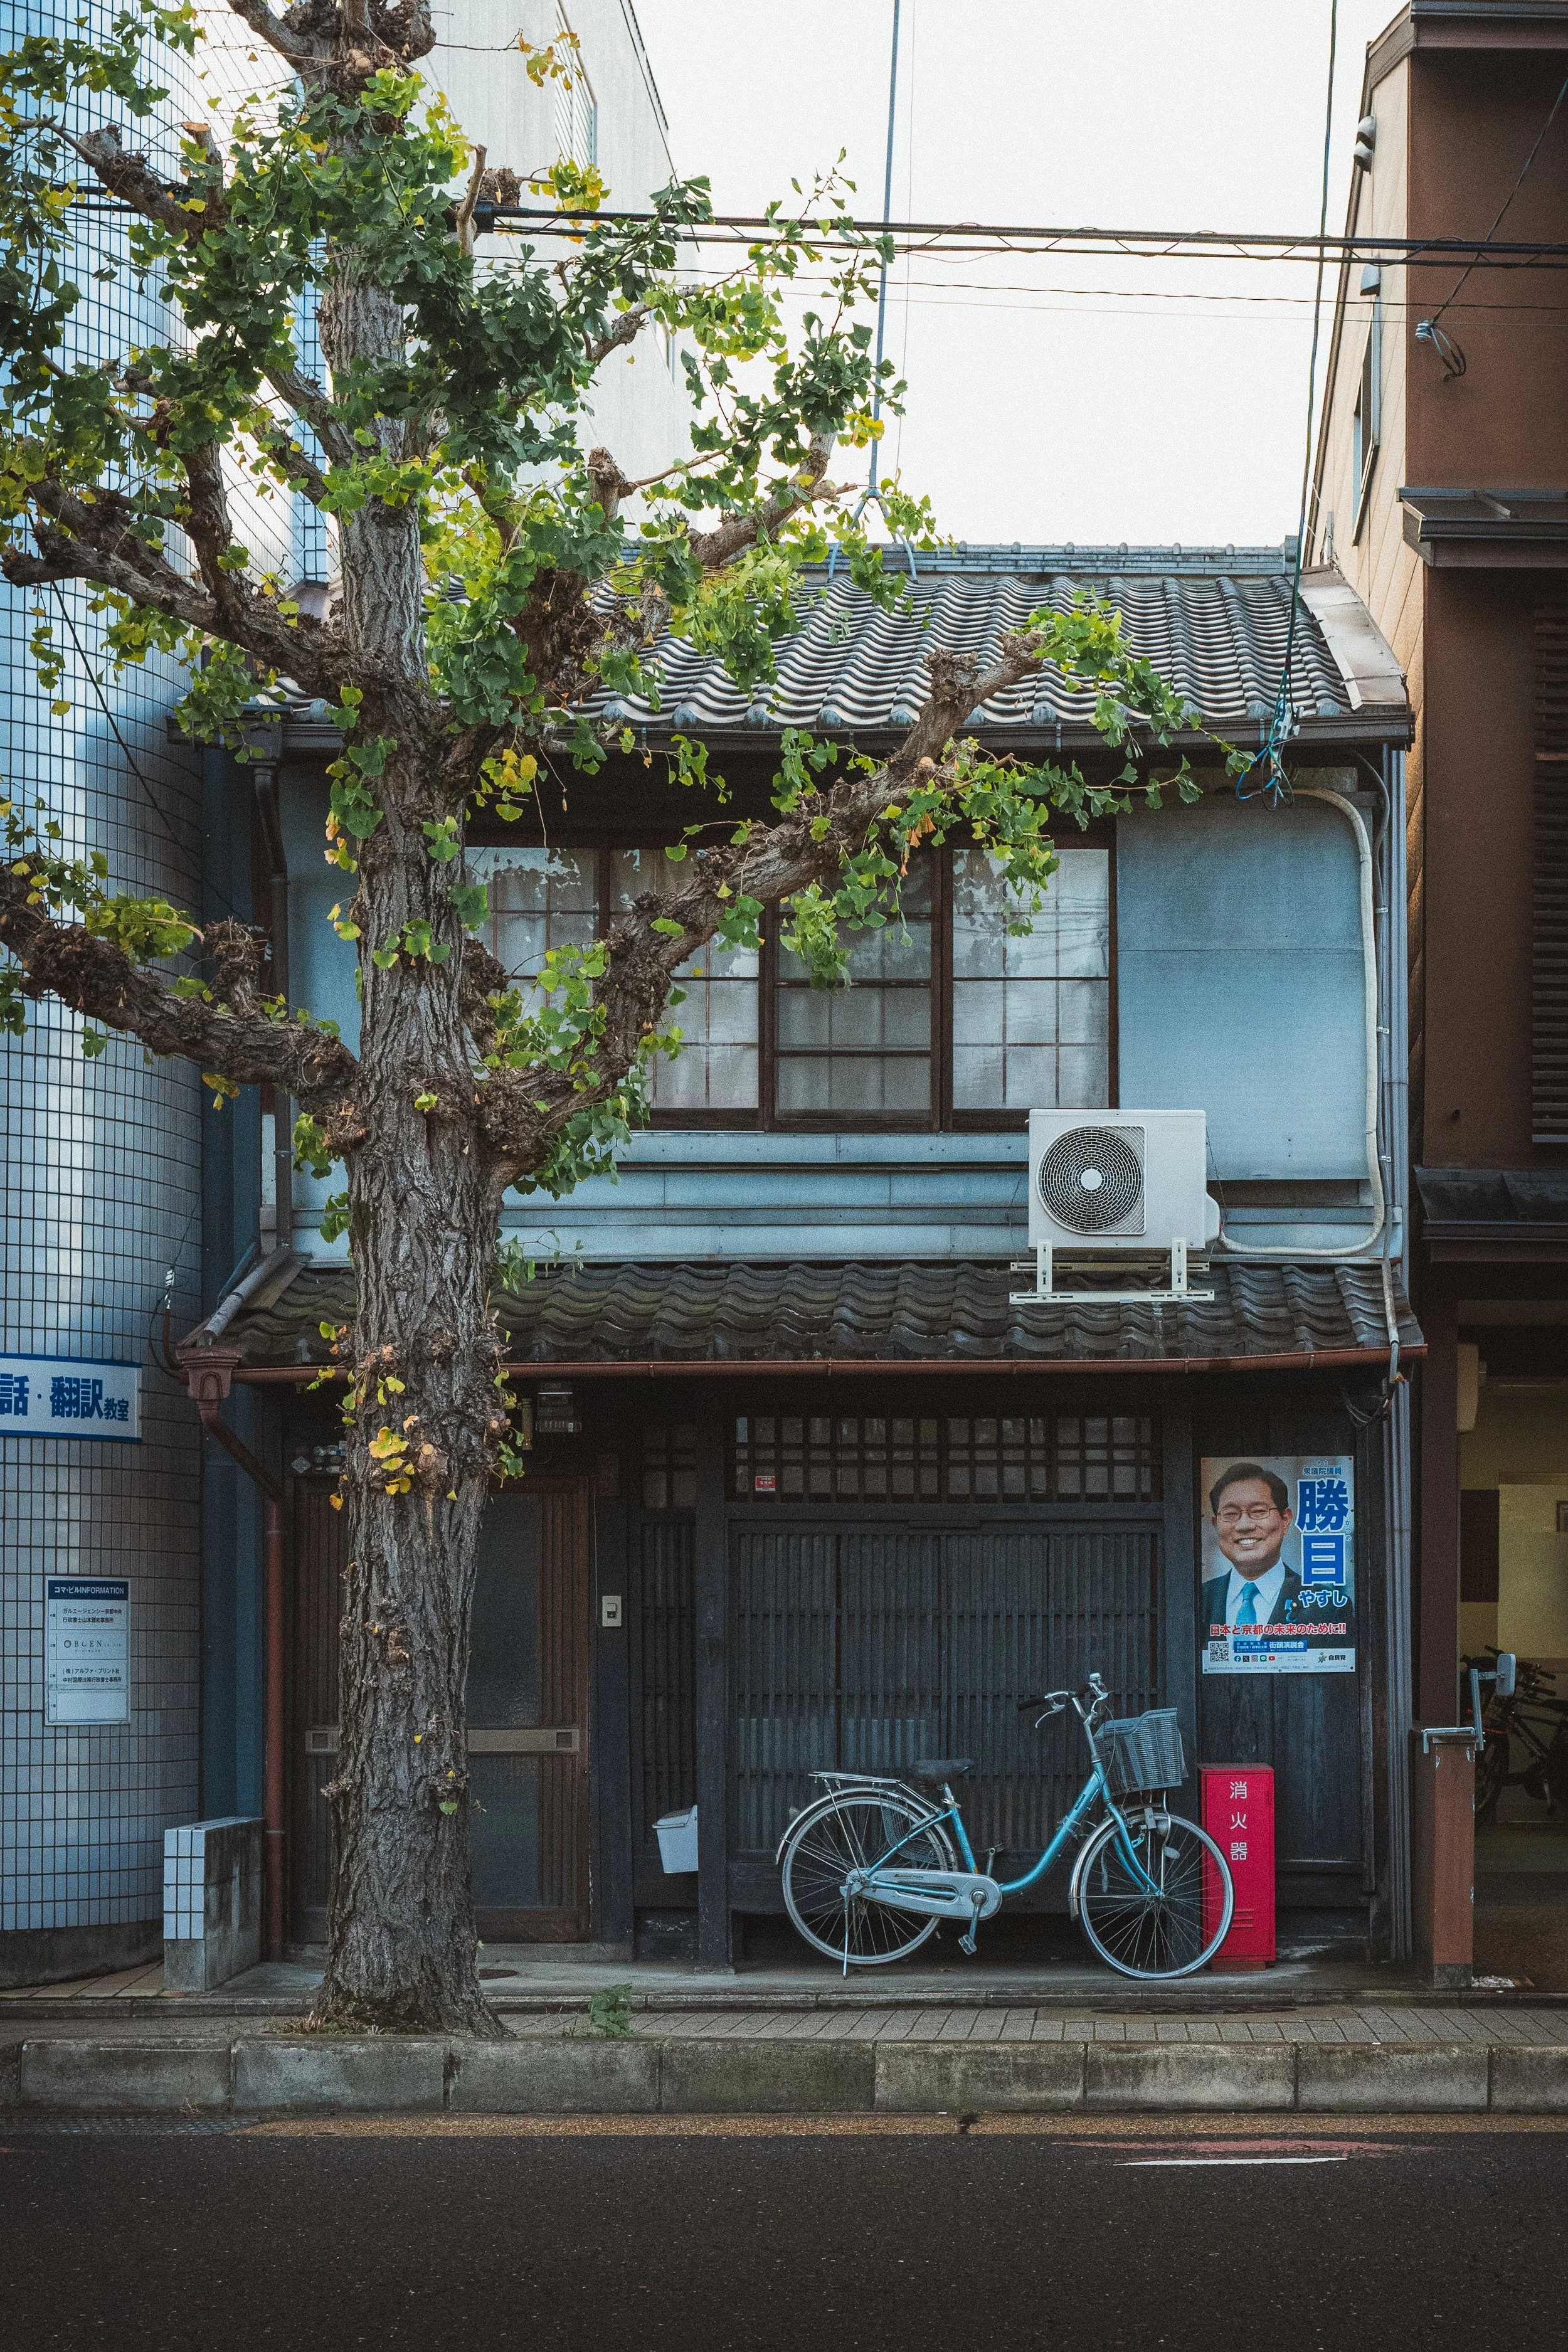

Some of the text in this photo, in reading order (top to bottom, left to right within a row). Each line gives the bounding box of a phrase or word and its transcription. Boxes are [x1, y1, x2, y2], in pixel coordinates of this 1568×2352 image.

[1303, 1467, 1342, 1475] 衆議院議員
[1298, 1479, 1348, 1586] 勝目
[1299, 1590, 1348, 1608] やすし
[1269, 1641, 1304, 1649] 街頭演説会
[1074, 1794, 1086, 1811] National
[1229, 1781, 1248, 1860] 消火器
